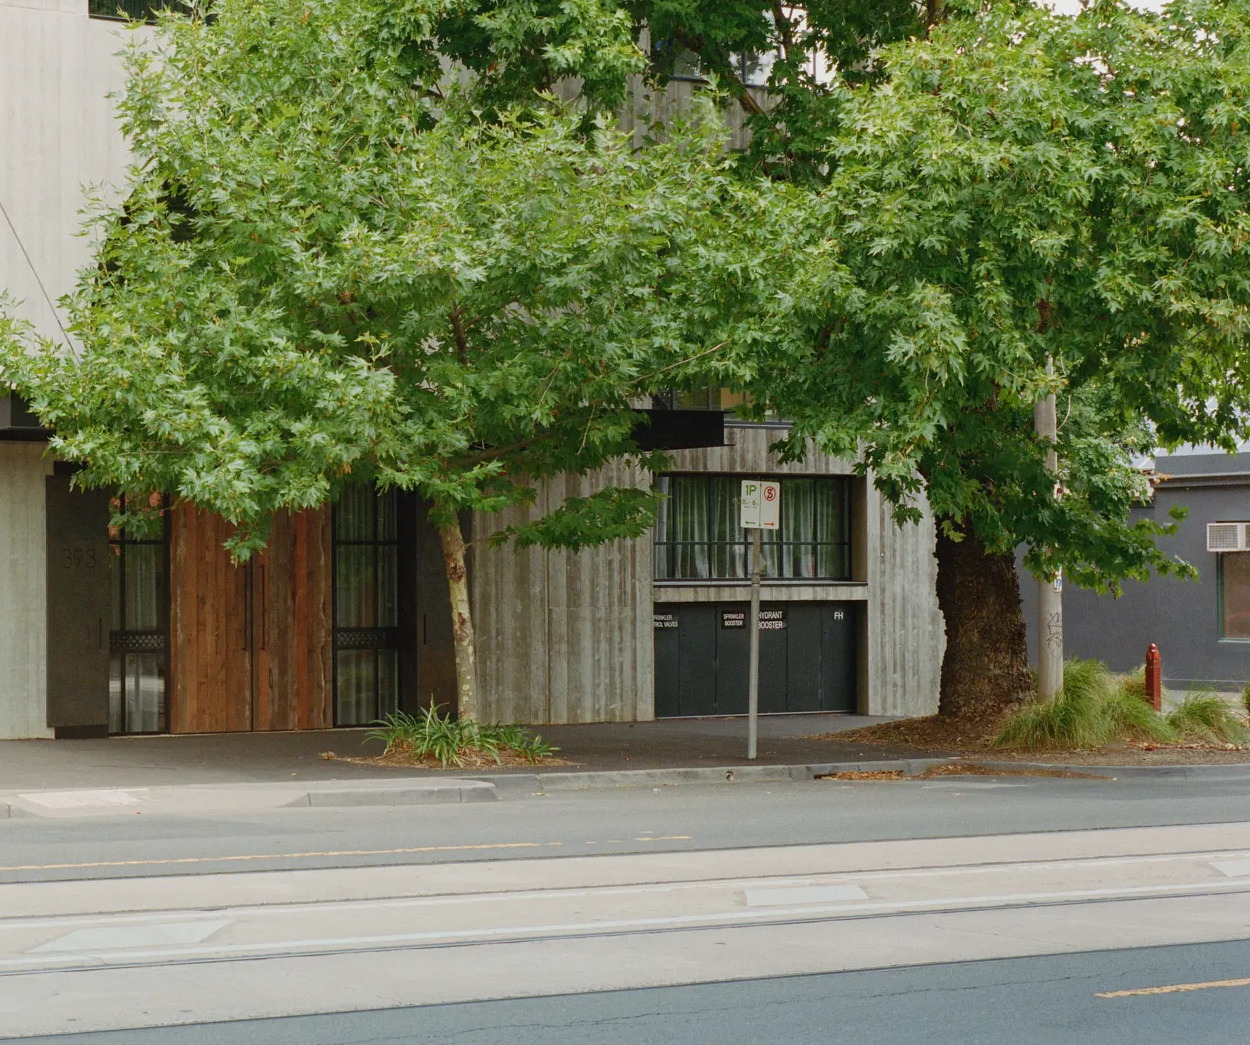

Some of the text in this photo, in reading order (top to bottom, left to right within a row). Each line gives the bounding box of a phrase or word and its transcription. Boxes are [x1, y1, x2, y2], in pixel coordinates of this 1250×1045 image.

[745, 485, 756, 496] 1P
[62, 548, 97, 569] 393
[833, 611, 844, 620] FH
[724, 619, 744, 627] BOOSTER
